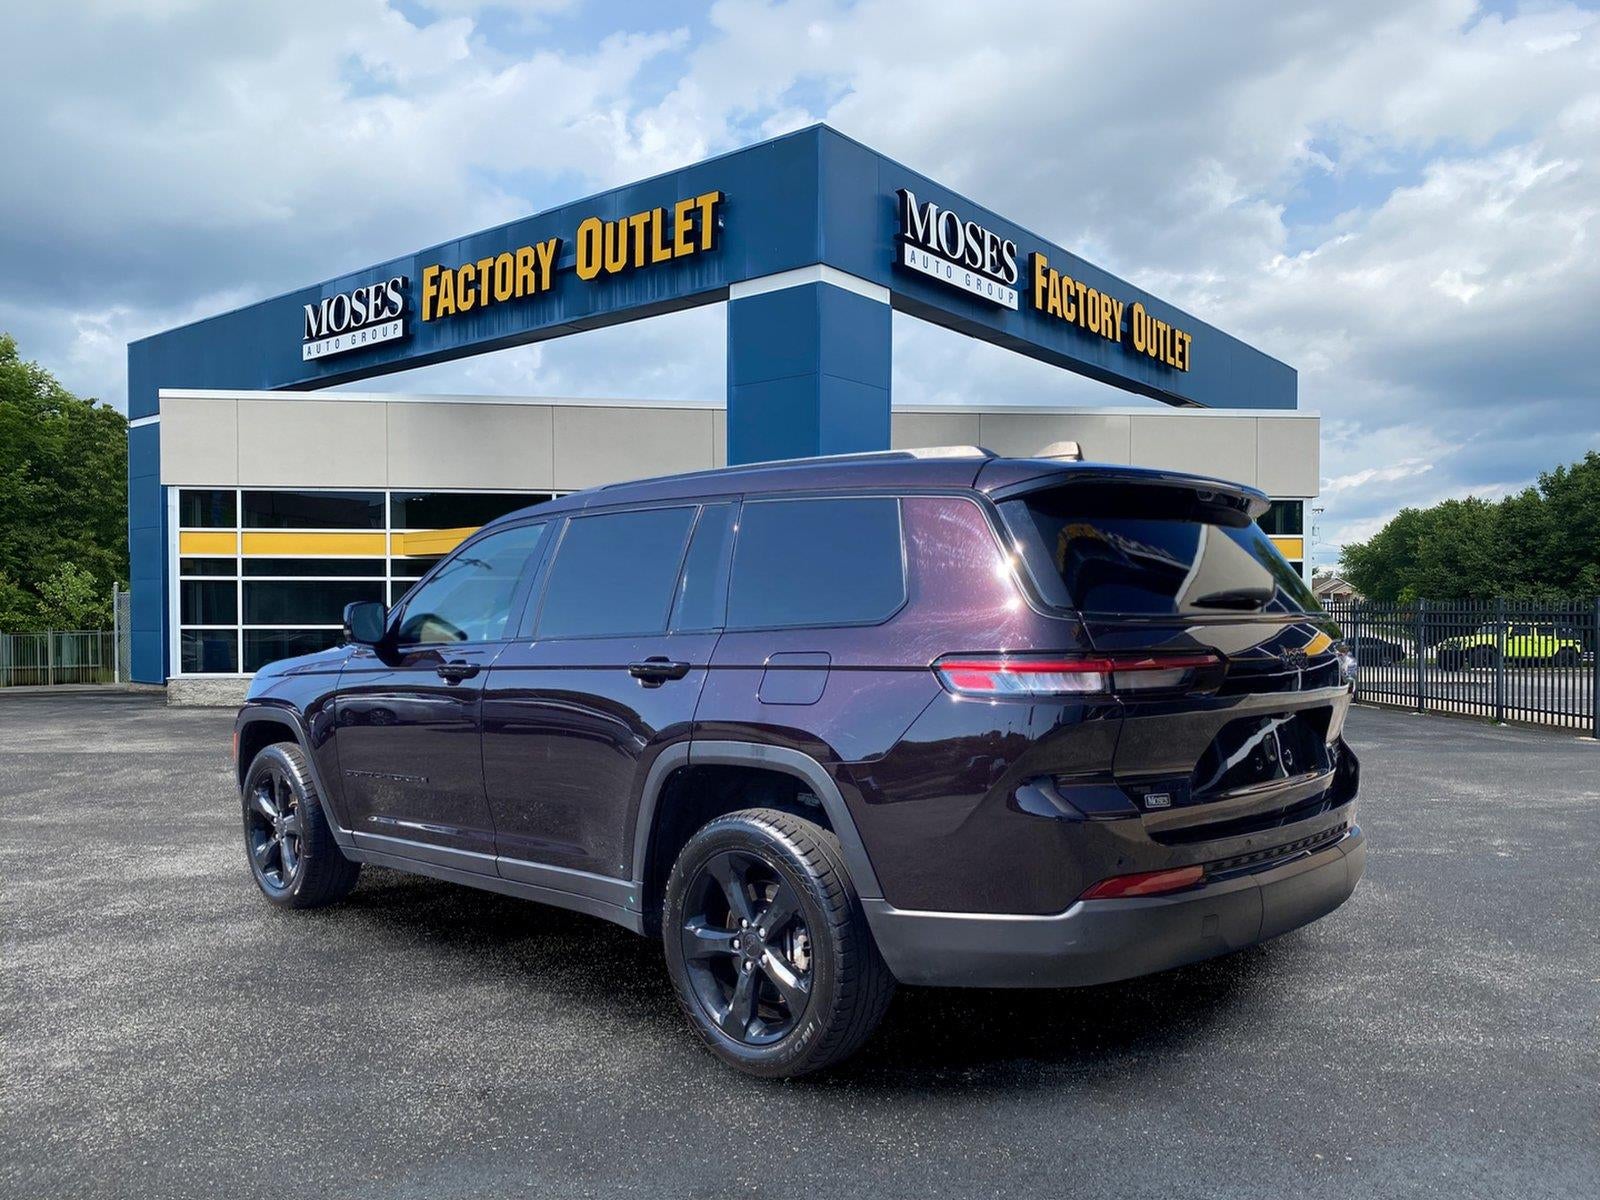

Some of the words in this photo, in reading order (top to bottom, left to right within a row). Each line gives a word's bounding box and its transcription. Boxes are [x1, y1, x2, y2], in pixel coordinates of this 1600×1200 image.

[421, 237, 558, 322] FACTORY
[576, 190, 720, 281] OUTLET
[904, 188, 1018, 285] MOSES
[303, 276, 403, 340] MOSES
[909, 250, 953, 279] AUTO
[965, 273, 1014, 304] GROUP
[1034, 251, 1124, 343] FACTORY
[1133, 302, 1192, 372] OUTLET
[306, 338, 340, 356] AUTO
[351, 323, 399, 345] GROUP
